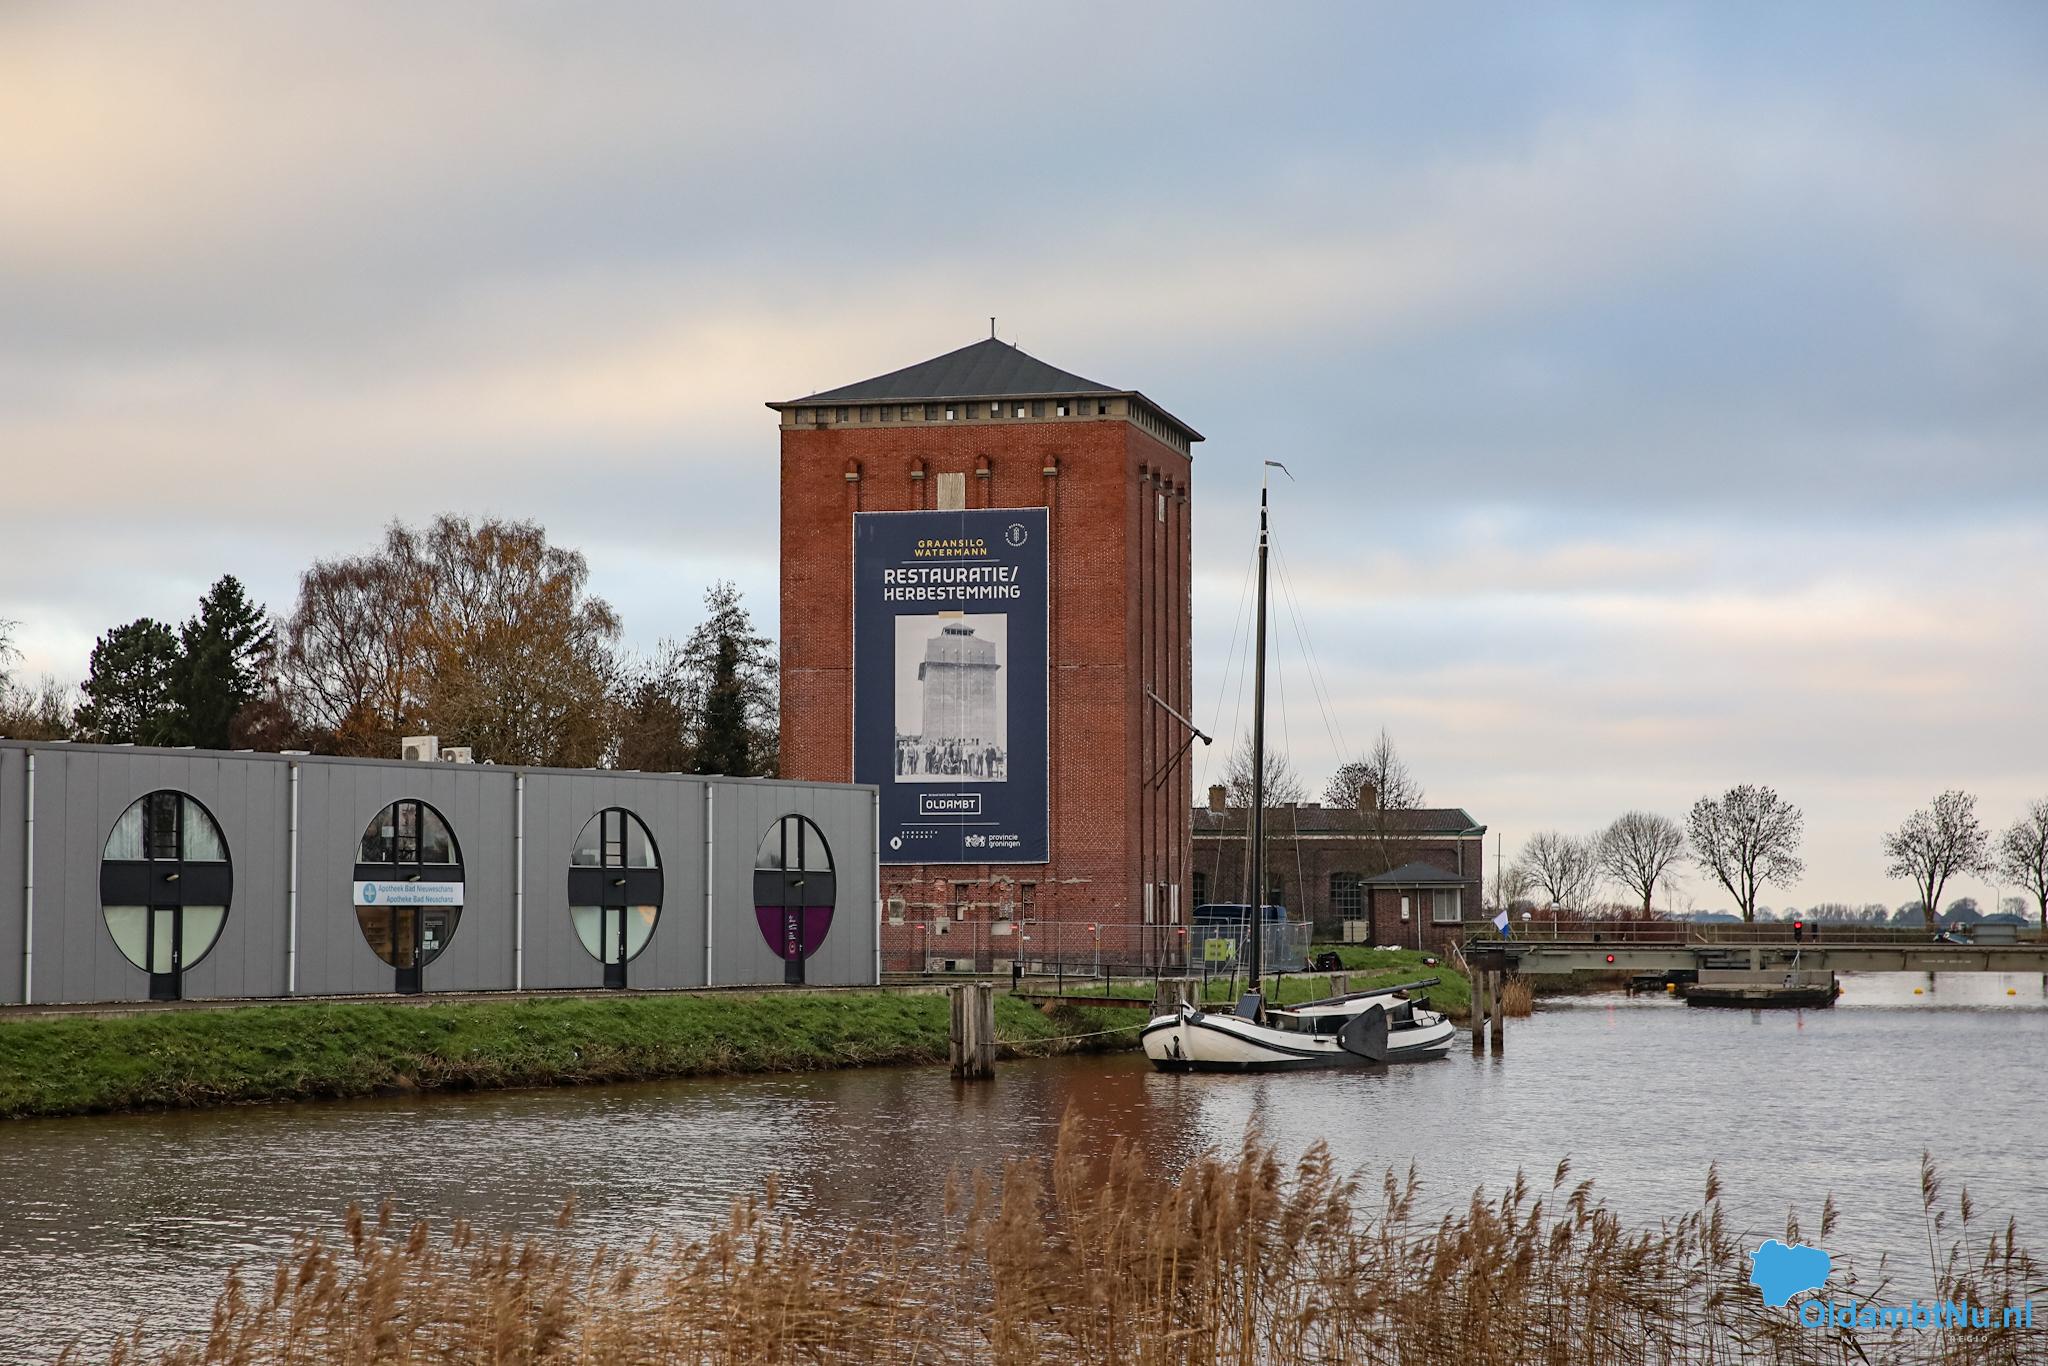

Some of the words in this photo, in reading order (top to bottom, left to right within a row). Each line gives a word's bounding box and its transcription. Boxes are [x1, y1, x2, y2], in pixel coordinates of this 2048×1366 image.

[918, 539, 984, 548] GRAANSILO
[914, 548, 987, 557] WATERMANN
[884, 566, 1019, 584] RESTAURATIE/
[884, 585, 1021, 601] HERBESTEMMING
[926, 799, 976, 810] OLDAMBT
[988, 834, 1018, 843] provincie
[988, 840, 1021, 849] groningen
[378, 884, 404, 893] Apotheek
[405, 884, 416, 892] Bad
[386, 895, 412, 904] Apotheke
[413, 895, 424, 903] Bad
